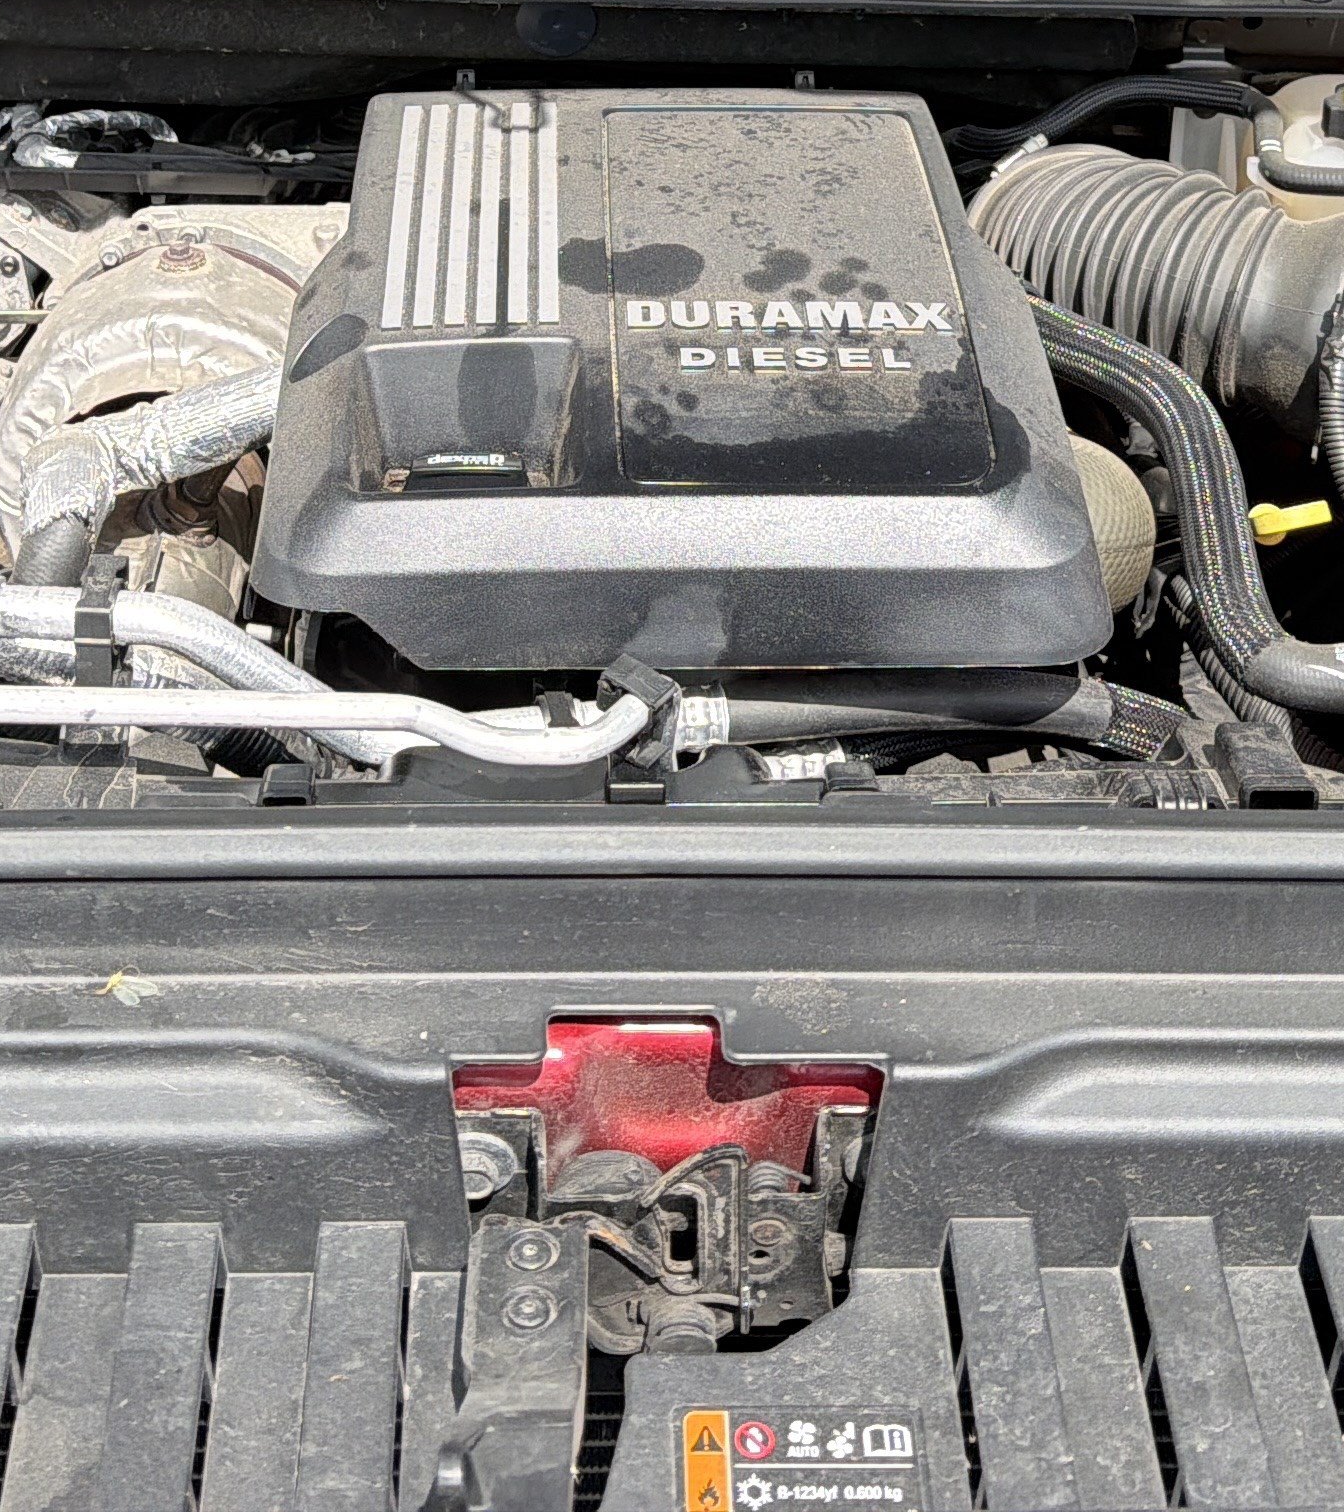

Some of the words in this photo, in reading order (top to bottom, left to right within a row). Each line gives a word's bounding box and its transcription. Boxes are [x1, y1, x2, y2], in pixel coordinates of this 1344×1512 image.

[627, 300, 954, 331] DURAMAX
[679, 347, 912, 371] DIESEL
[786, 1445, 820, 1458] AUTO
[884, 1485, 904, 1503] kg
